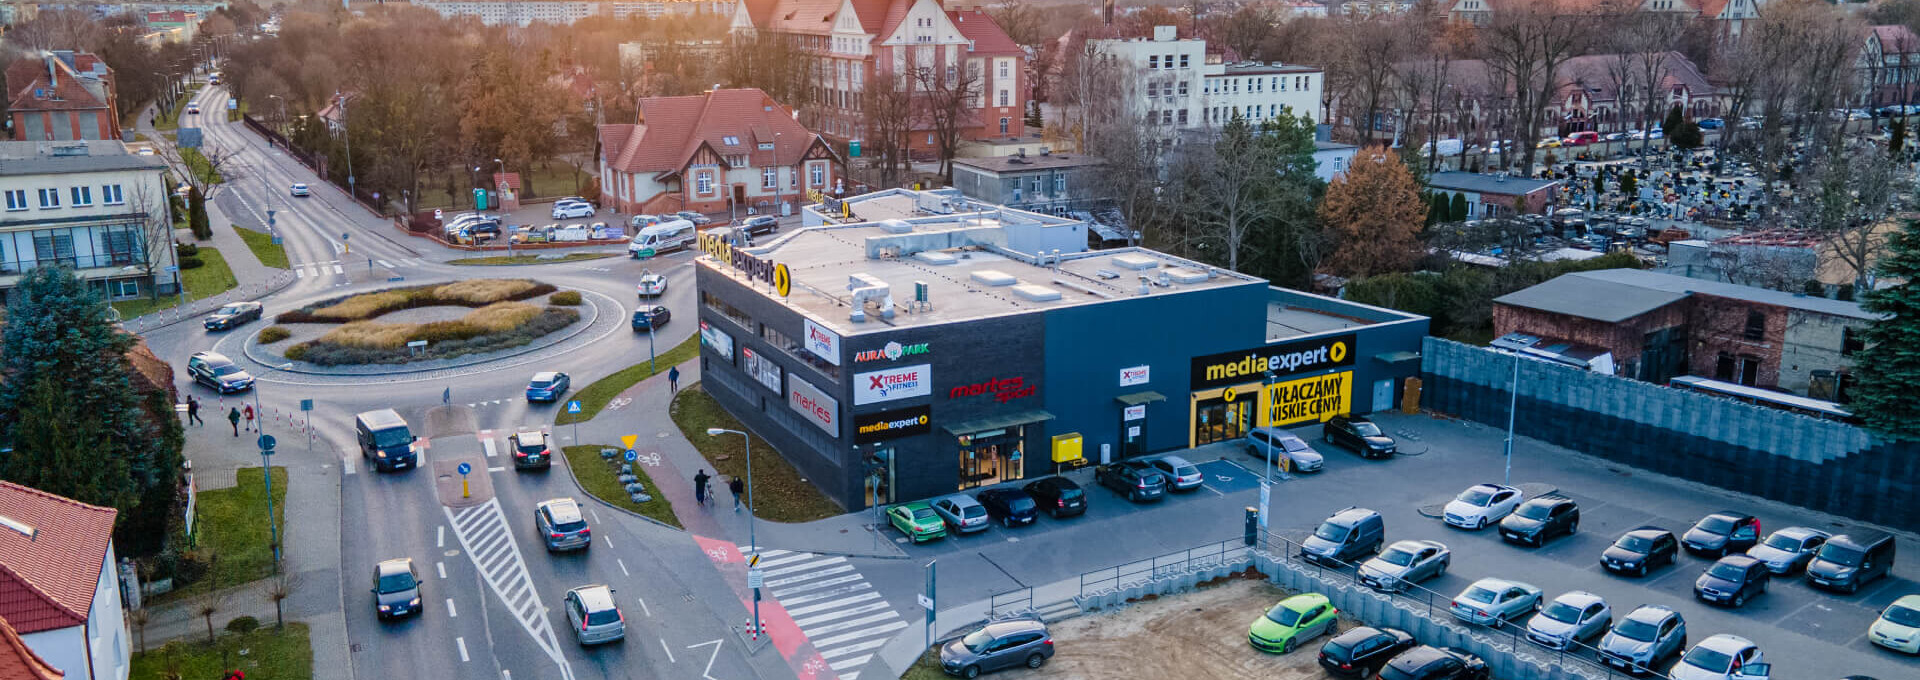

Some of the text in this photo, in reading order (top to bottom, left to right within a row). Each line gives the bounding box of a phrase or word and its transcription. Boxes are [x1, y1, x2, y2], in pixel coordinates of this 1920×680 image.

[855, 343, 930, 362] AURA PARK
[1206, 345, 1327, 381] mediaexpert
[869, 372, 918, 391] XTREME
[950, 376, 1024, 399] martes
[993, 384, 1036, 404] sport
[793, 391, 831, 424] martes
[1269, 395, 1342, 422] NISKIE CENY!
[860, 416, 918, 434] mediaexpert
